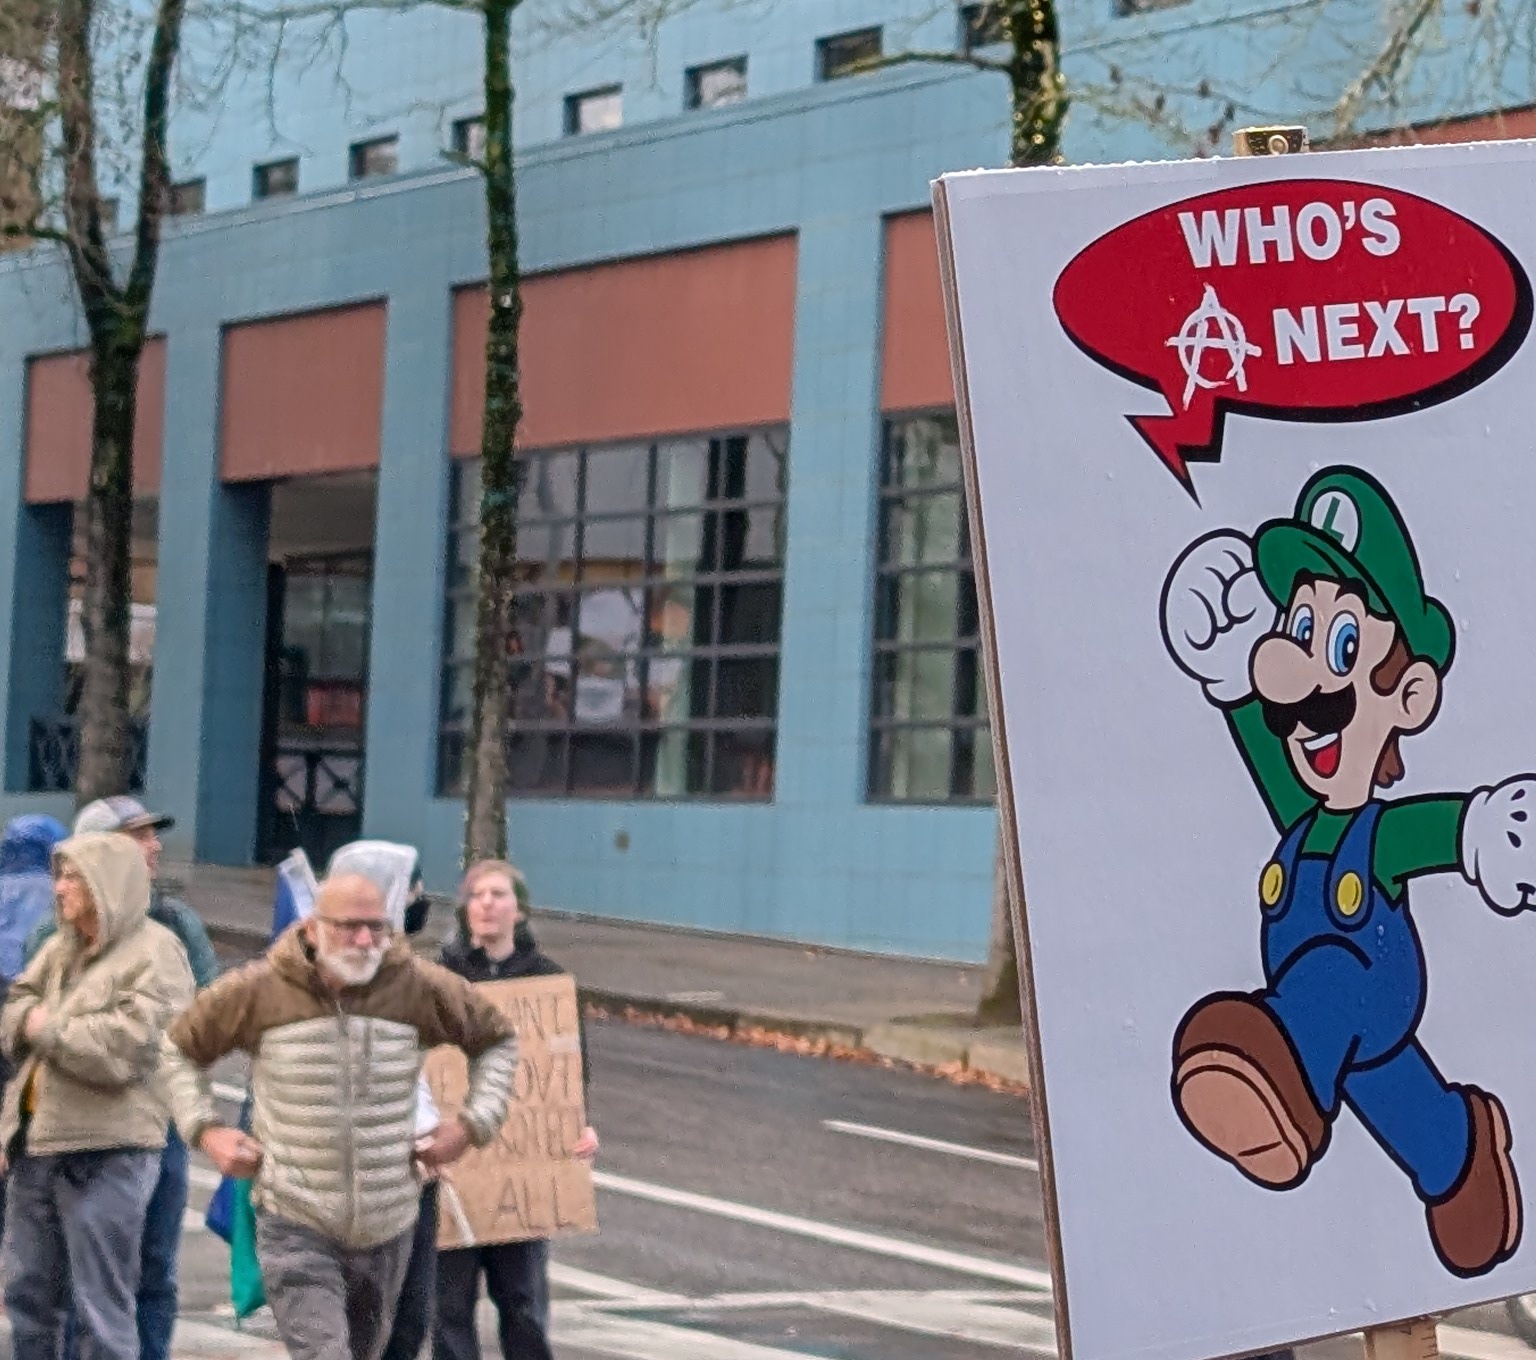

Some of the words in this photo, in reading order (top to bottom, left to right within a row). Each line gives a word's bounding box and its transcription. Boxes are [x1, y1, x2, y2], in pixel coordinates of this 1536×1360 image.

[1177, 197, 1401, 269] WHO'S
[1272, 293, 1481, 366] NEXT?
[1322, 495, 1345, 544] L
